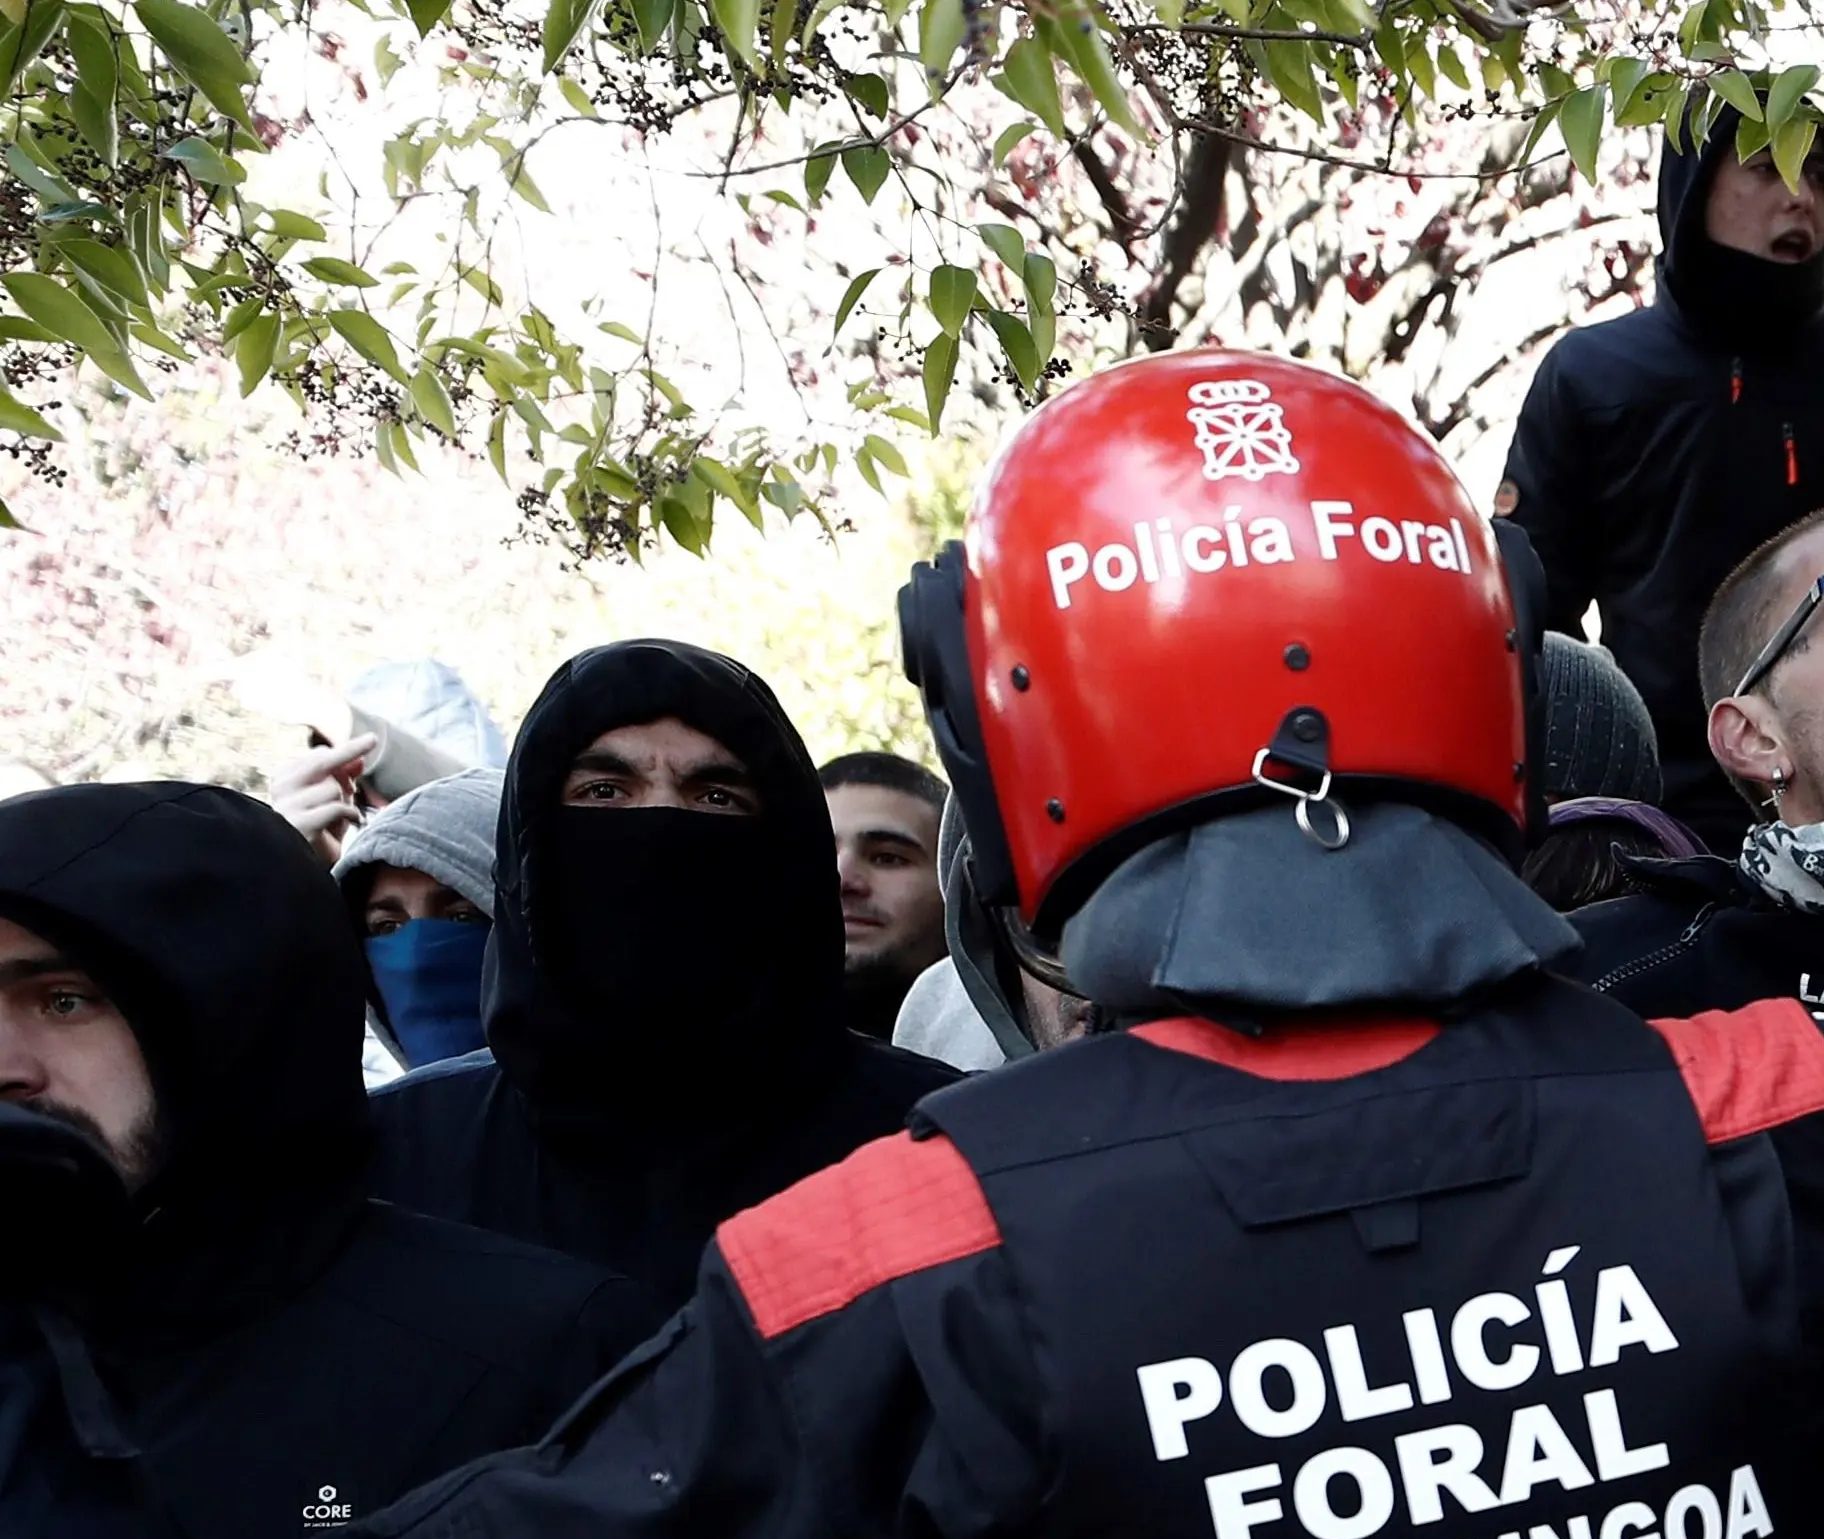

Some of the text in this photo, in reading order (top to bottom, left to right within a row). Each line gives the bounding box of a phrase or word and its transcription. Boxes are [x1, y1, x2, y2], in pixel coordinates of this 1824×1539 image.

[1047, 501, 1472, 609] Policía Foral
[1137, 1245, 1680, 1461] POLICÍA
[302, 1504, 353, 1520] CORE
